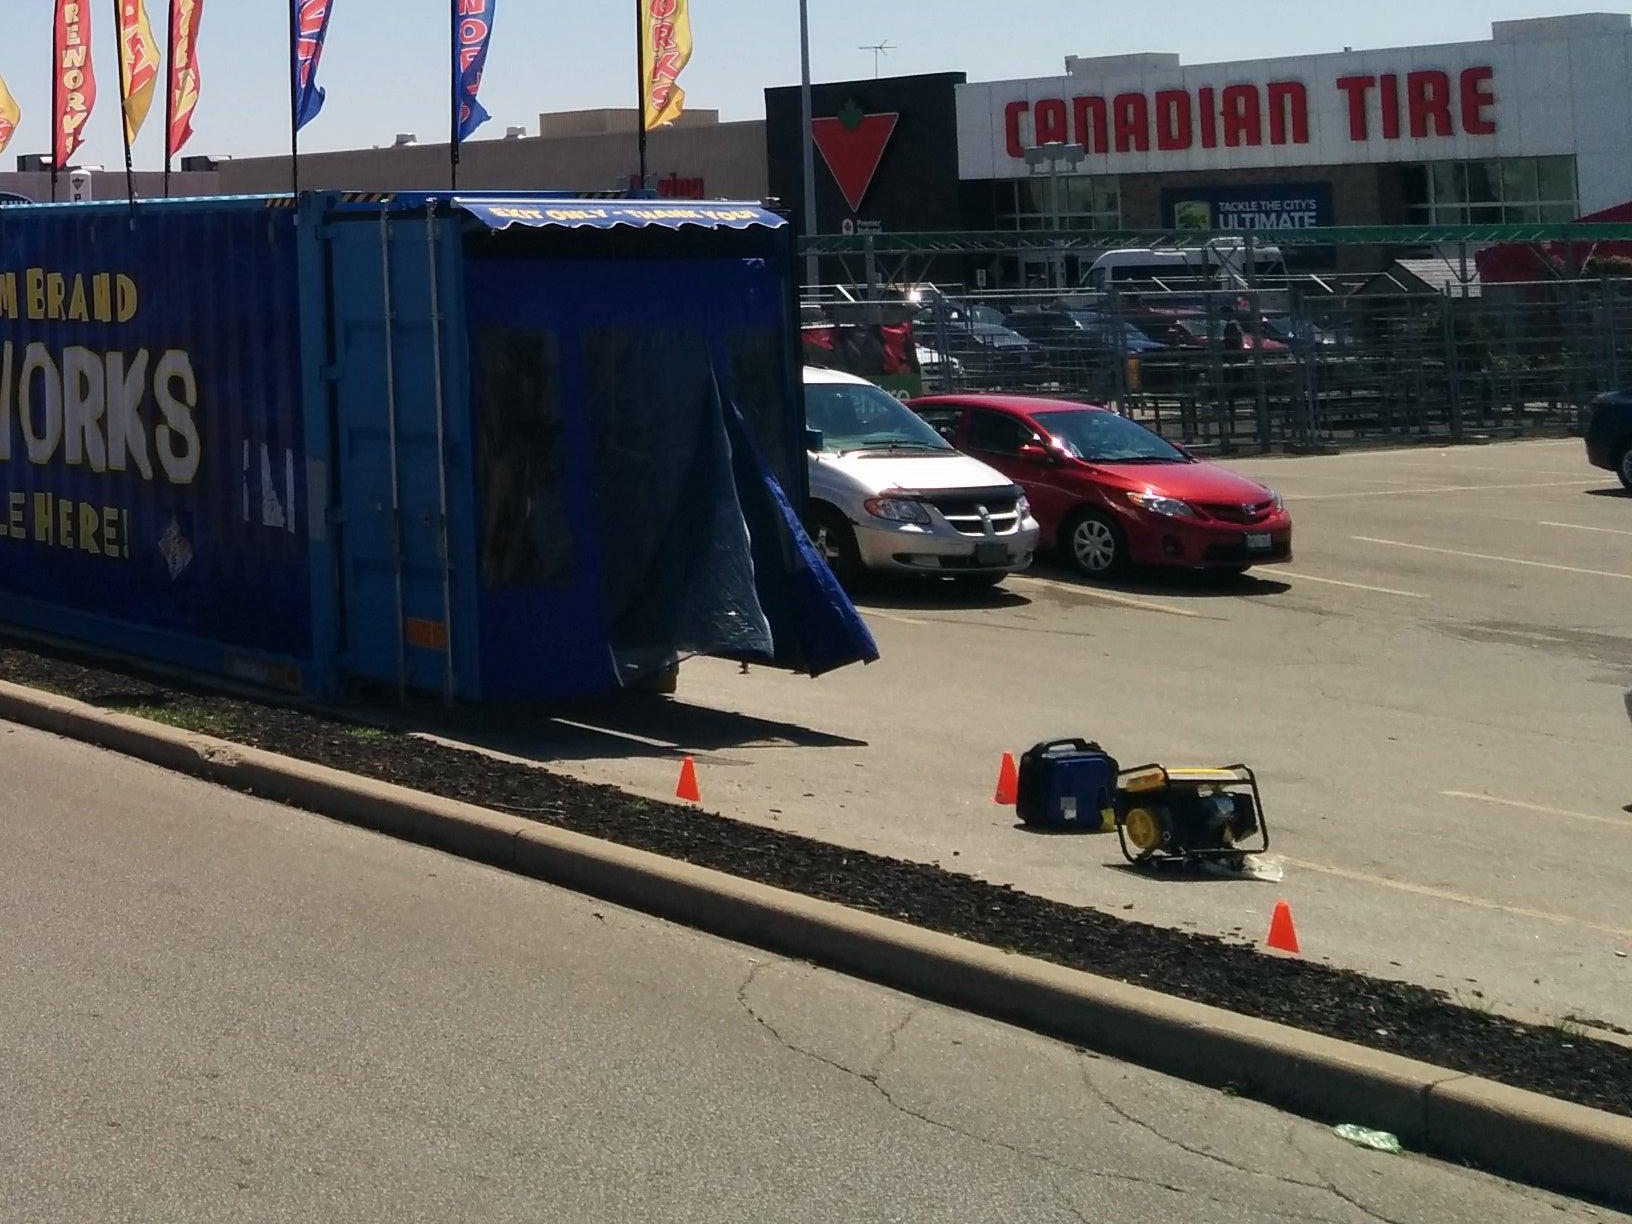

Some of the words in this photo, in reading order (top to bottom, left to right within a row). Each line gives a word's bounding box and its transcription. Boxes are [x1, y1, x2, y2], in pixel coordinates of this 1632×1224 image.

[1005, 82, 1309, 158] CANADIAN
[1336, 66, 1496, 141] TIRE
[545, 209, 609, 220] ONLY
[1219, 201, 1258, 211] TACKLE
[1261, 200, 1281, 210] THE
[1283, 199, 1317, 210] CITY'S
[1219, 212, 1317, 229] ULTIMATE
[26, 267, 138, 323] BRAND
[34, 492, 130, 559] HERE!
